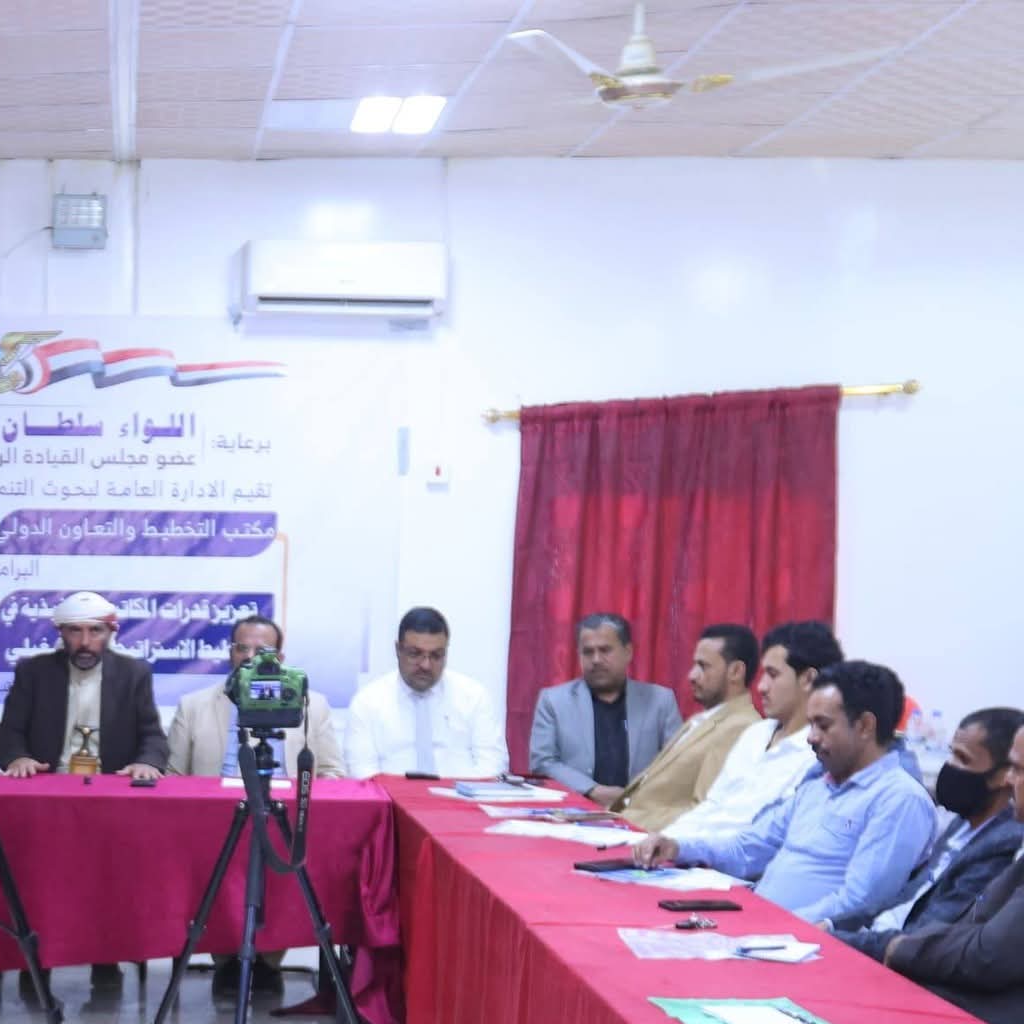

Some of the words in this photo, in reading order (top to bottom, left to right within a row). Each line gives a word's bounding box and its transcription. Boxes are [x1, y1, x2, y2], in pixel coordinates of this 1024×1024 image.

[2, 411, 103, 443] سلطان
[119, 411, 195, 443] اللواء
[22, 447, 85, 468] القيادة
[90, 448, 149, 470] مجلس
[156, 450, 196, 470] عضو
[41, 480, 99, 502] لبحوث
[106, 480, 163, 498] العامة
[170, 480, 226, 502] الادارة
[232, 483, 273, 504] تقيم
[58, 518, 137, 542] والتعاون
[141, 518, 216, 540] التخطيط
[222, 520, 275, 541] مكتب
[1, 596, 18, 628] في
